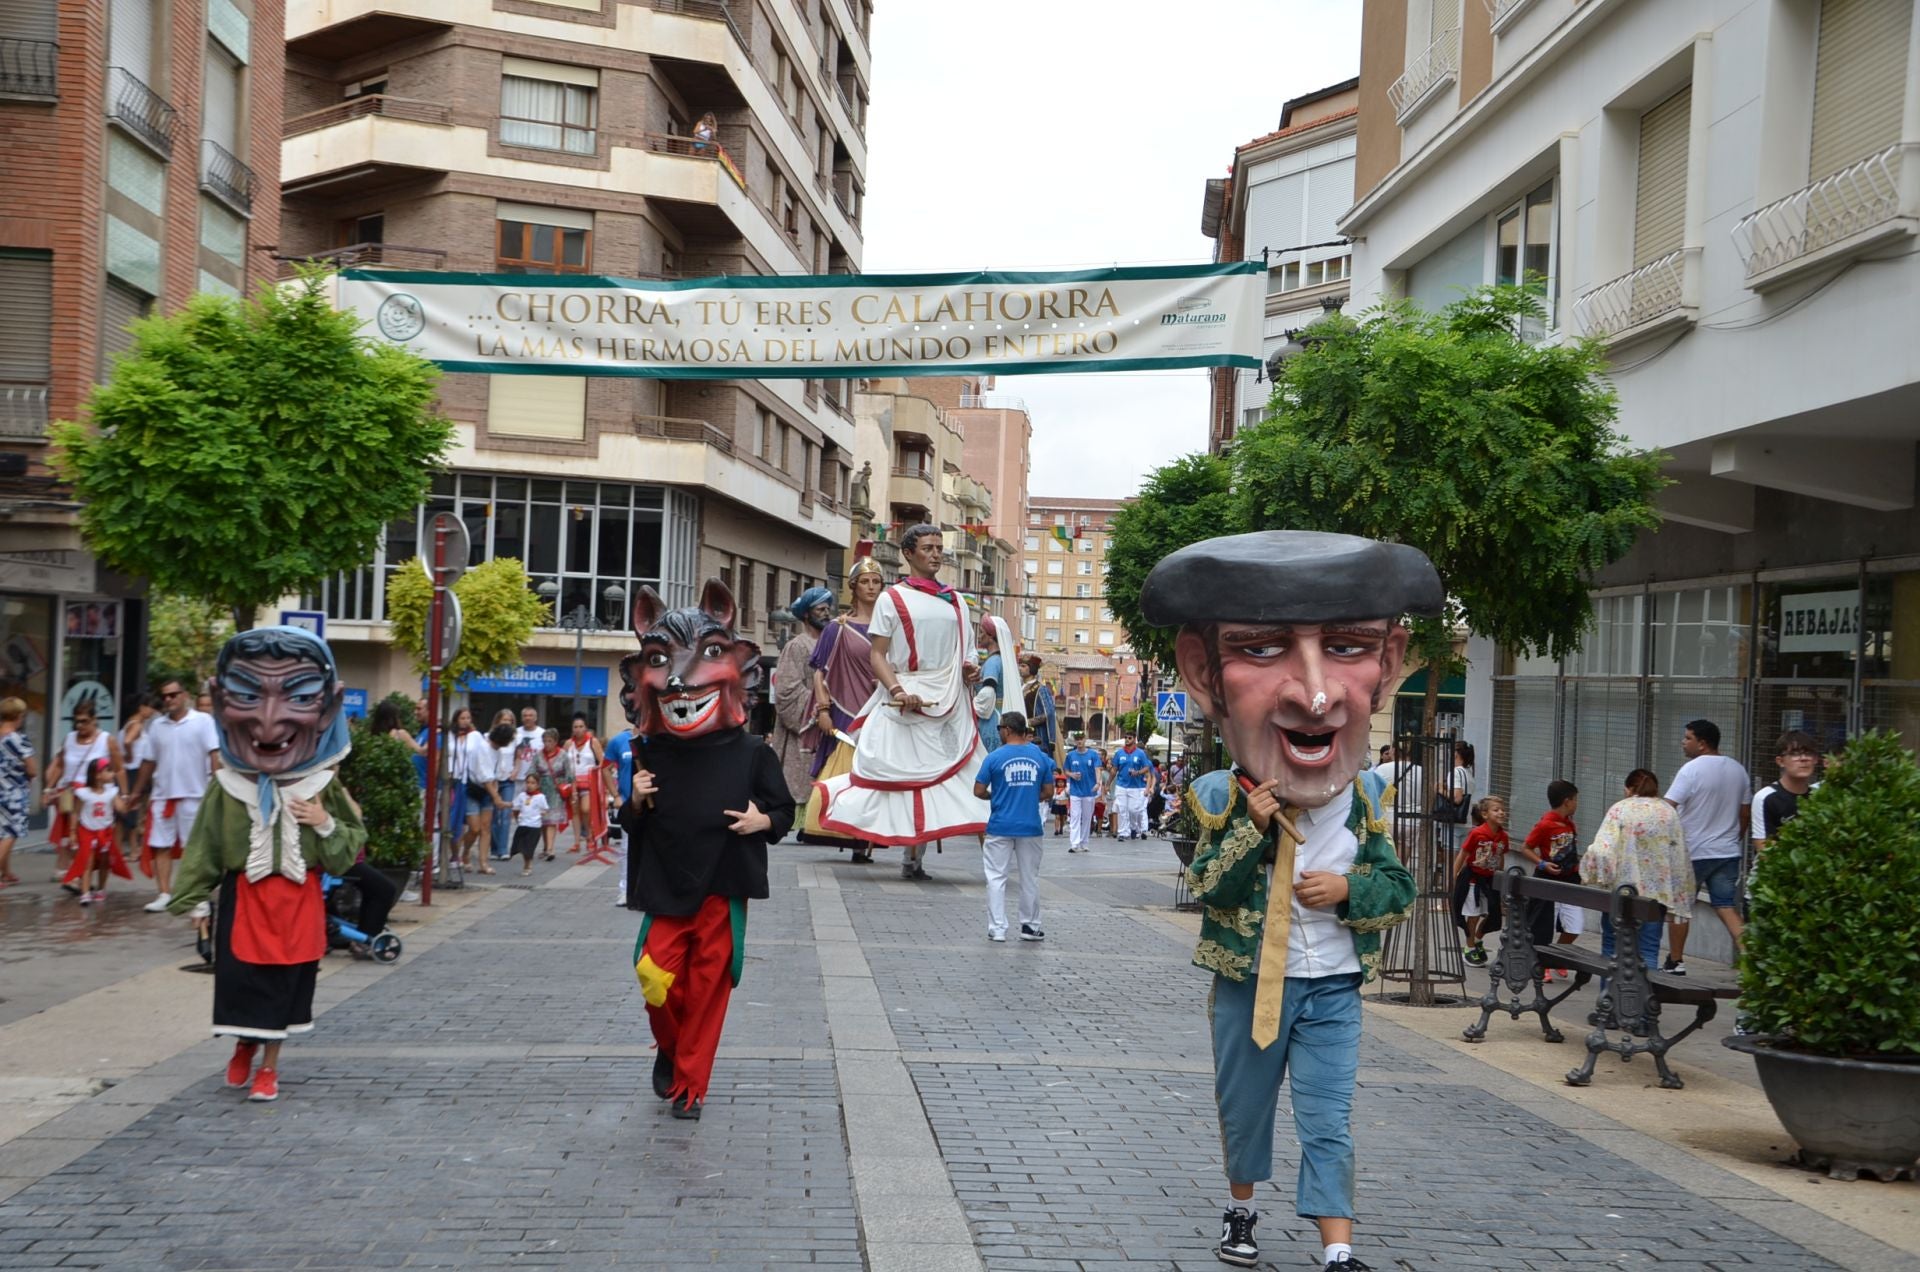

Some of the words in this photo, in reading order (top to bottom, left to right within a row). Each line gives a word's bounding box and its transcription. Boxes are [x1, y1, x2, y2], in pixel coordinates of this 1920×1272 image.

[468, 291, 680, 328] ...CHORRA,
[695, 294, 743, 326] TÚ
[755, 299, 832, 326] ERES
[850, 286, 1122, 325] CALAHORRA
[475, 333, 511, 358] LA
[519, 335, 584, 359] MAS
[594, 336, 753, 363] HERMOSA
[763, 338, 824, 363] DEL
[833, 334, 972, 363] MUNDO
[982, 329, 1119, 359] ENTERO
[1784, 606, 1860, 636] REBAJAS
[477, 668, 557, 681] talucía
